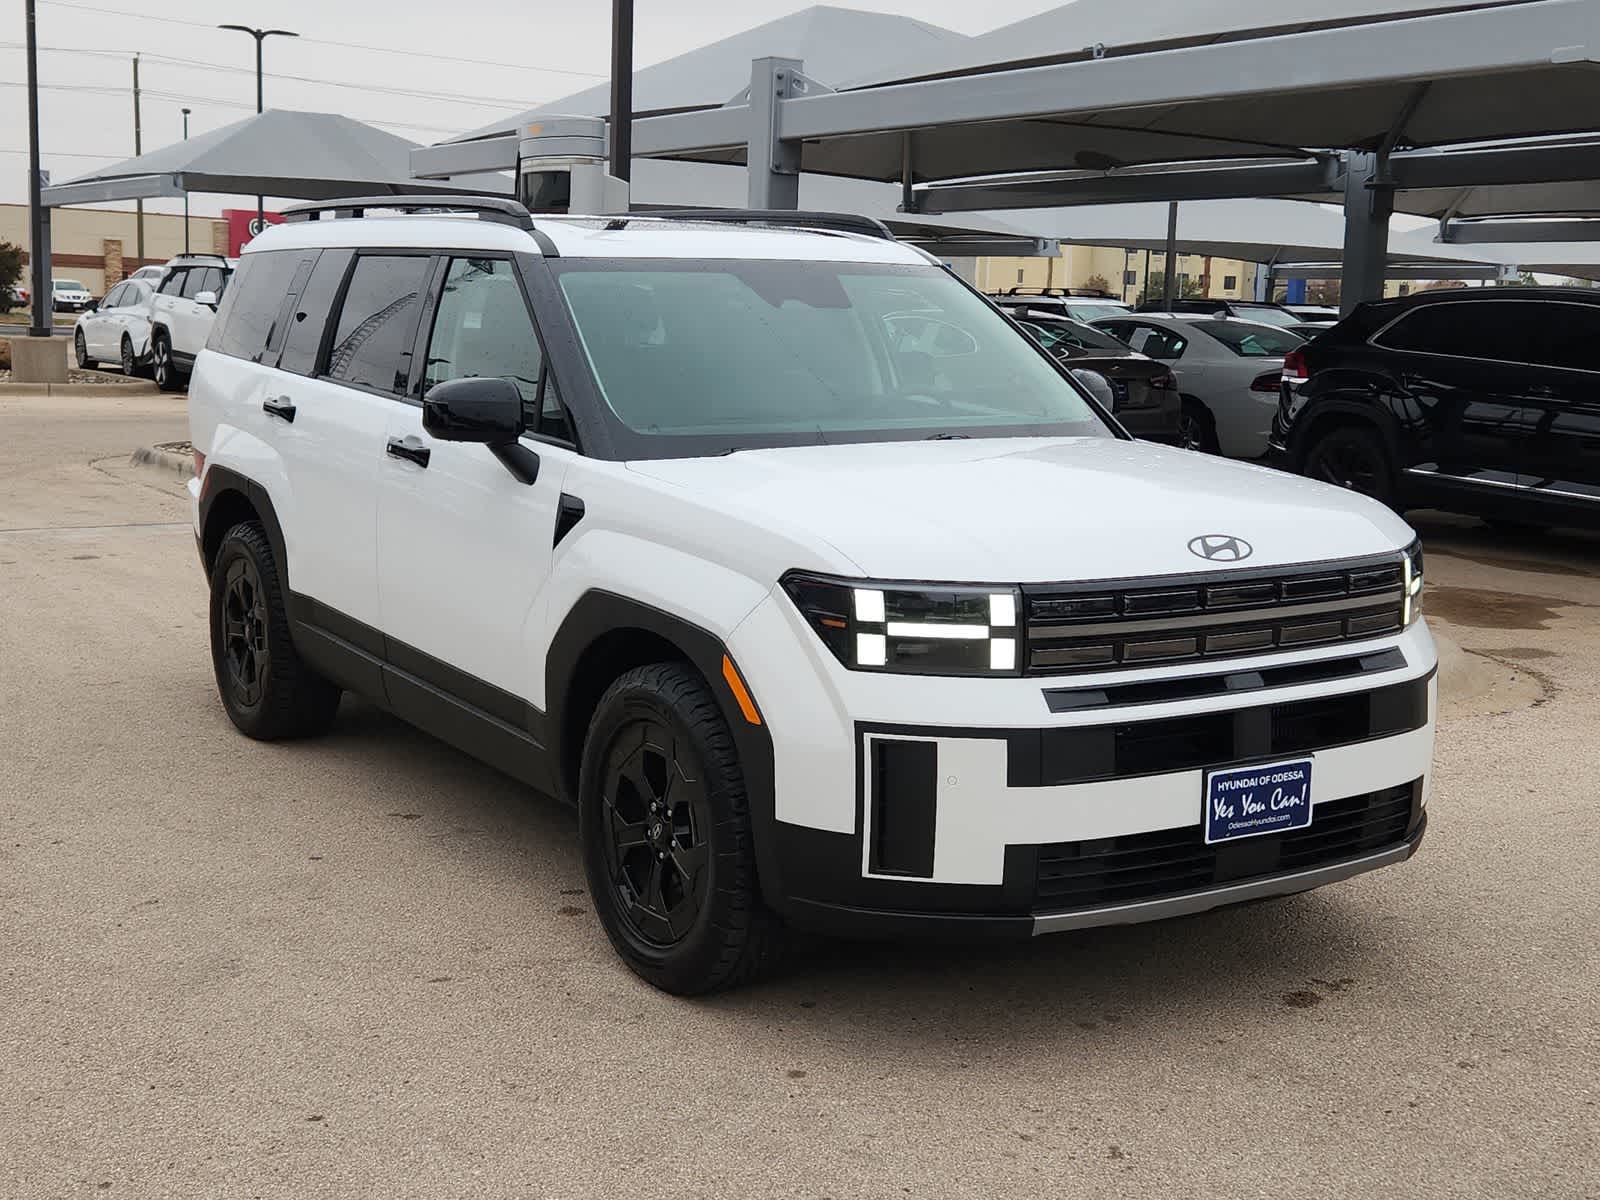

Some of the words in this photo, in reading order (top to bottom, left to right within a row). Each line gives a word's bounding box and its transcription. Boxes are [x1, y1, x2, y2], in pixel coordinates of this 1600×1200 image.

[1218, 778, 1258, 791] HYUNDAI
[1259, 775, 1271, 785] OF
[1271, 770, 1304, 783] ODESSA
[1213, 797, 1235, 821] Yes
[1242, 792, 1266, 816] You
[1270, 783, 1307, 811] Can!
[1228, 814, 1291, 830] OdessaHyundai.com
